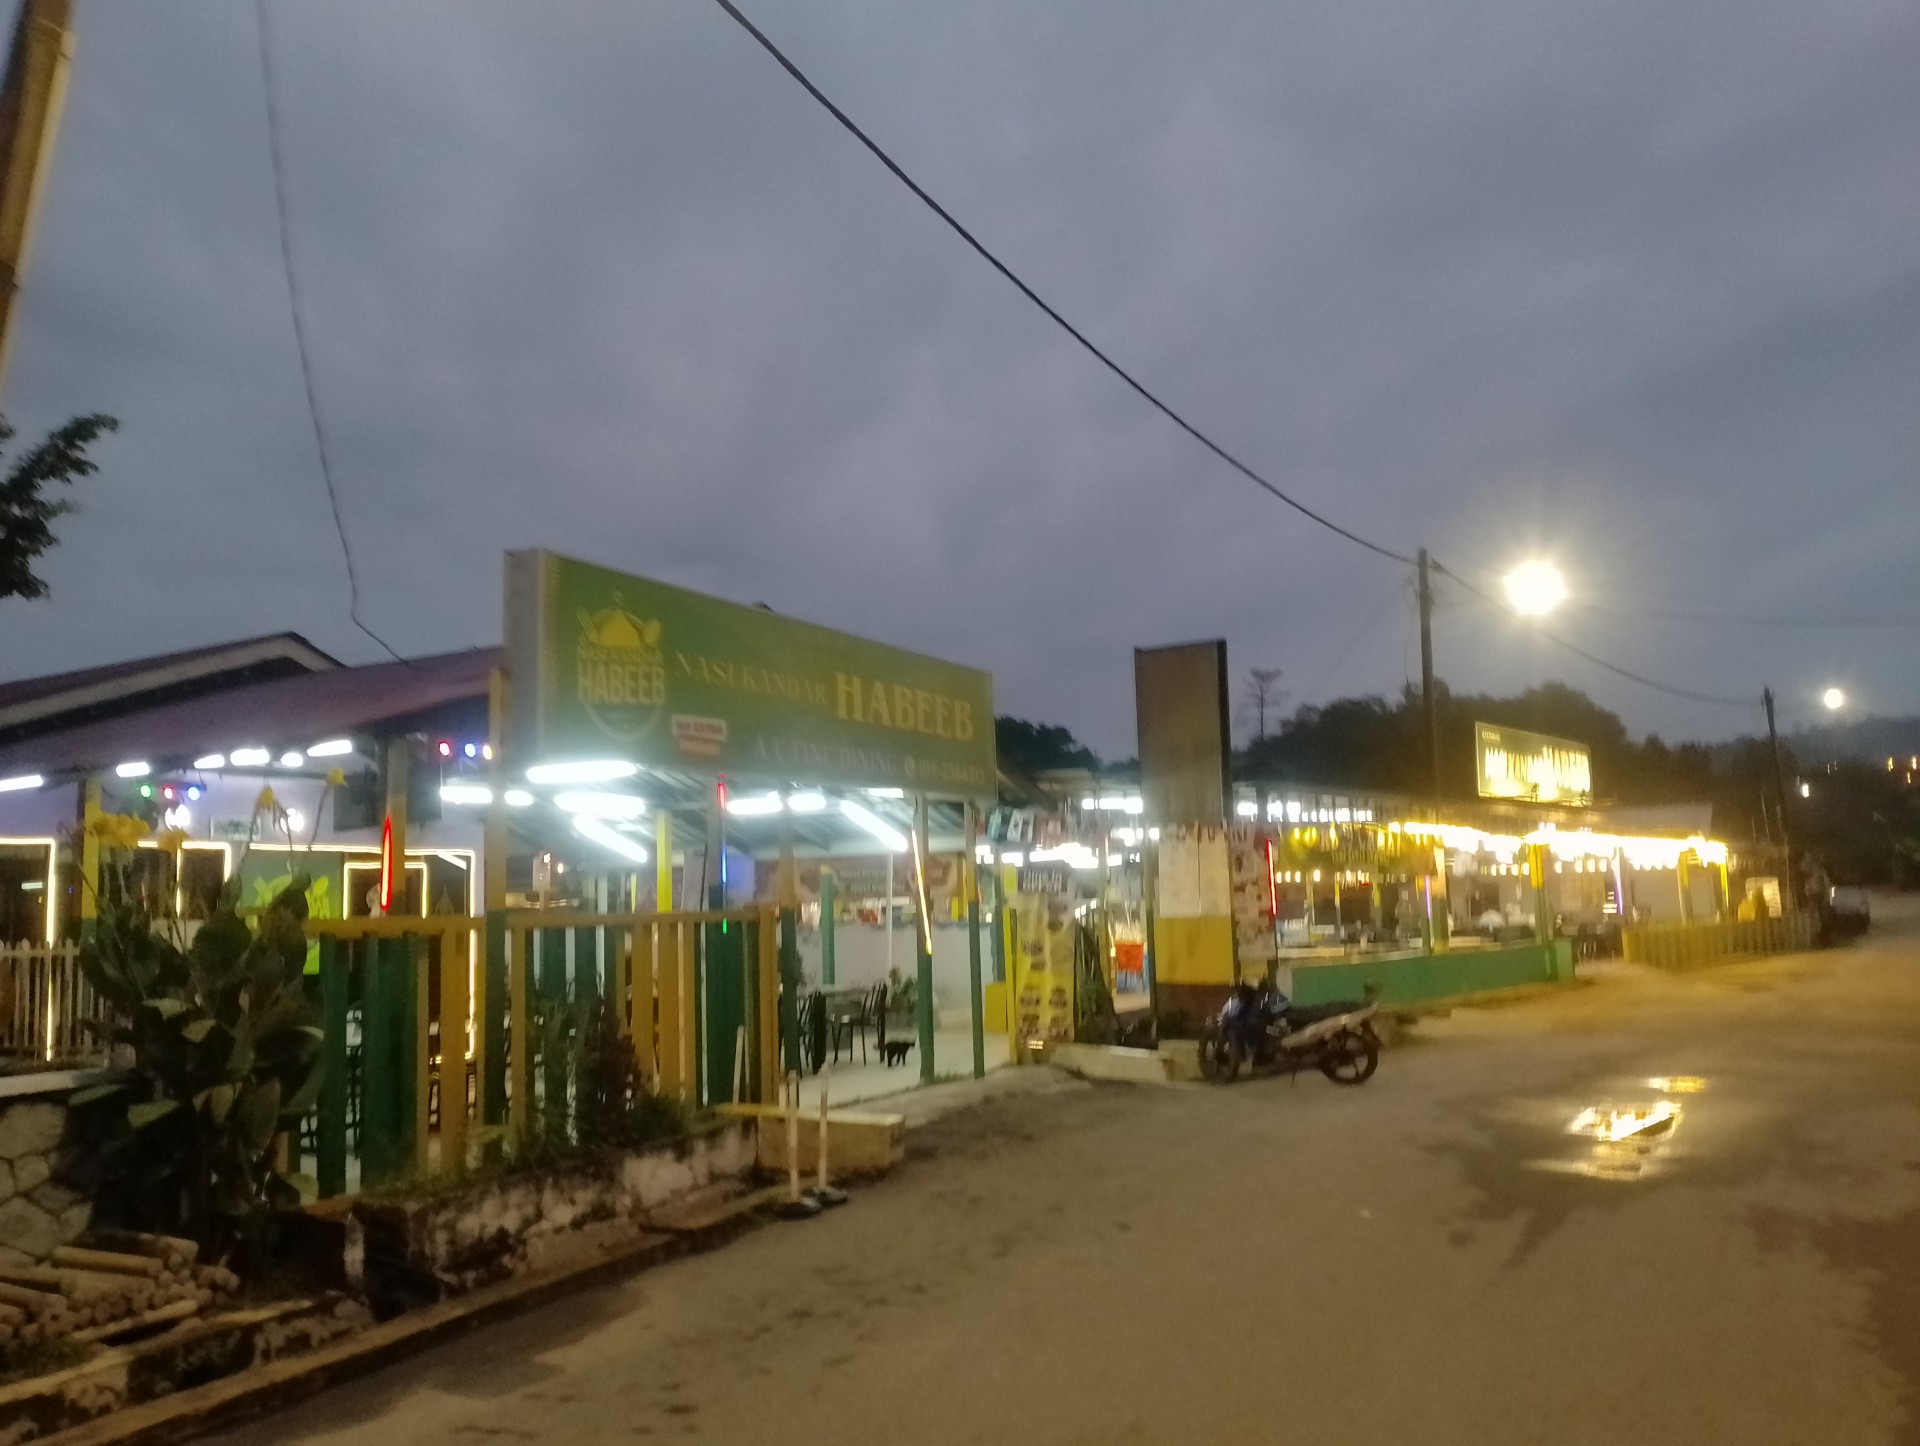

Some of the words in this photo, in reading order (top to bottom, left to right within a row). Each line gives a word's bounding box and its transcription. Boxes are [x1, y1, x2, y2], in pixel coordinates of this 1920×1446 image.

[577, 660, 665, 705] HABEEB
[675, 650, 735, 687] NASI
[742, 665, 827, 706] KANDAR
[836, 672, 974, 742] HABEEB
